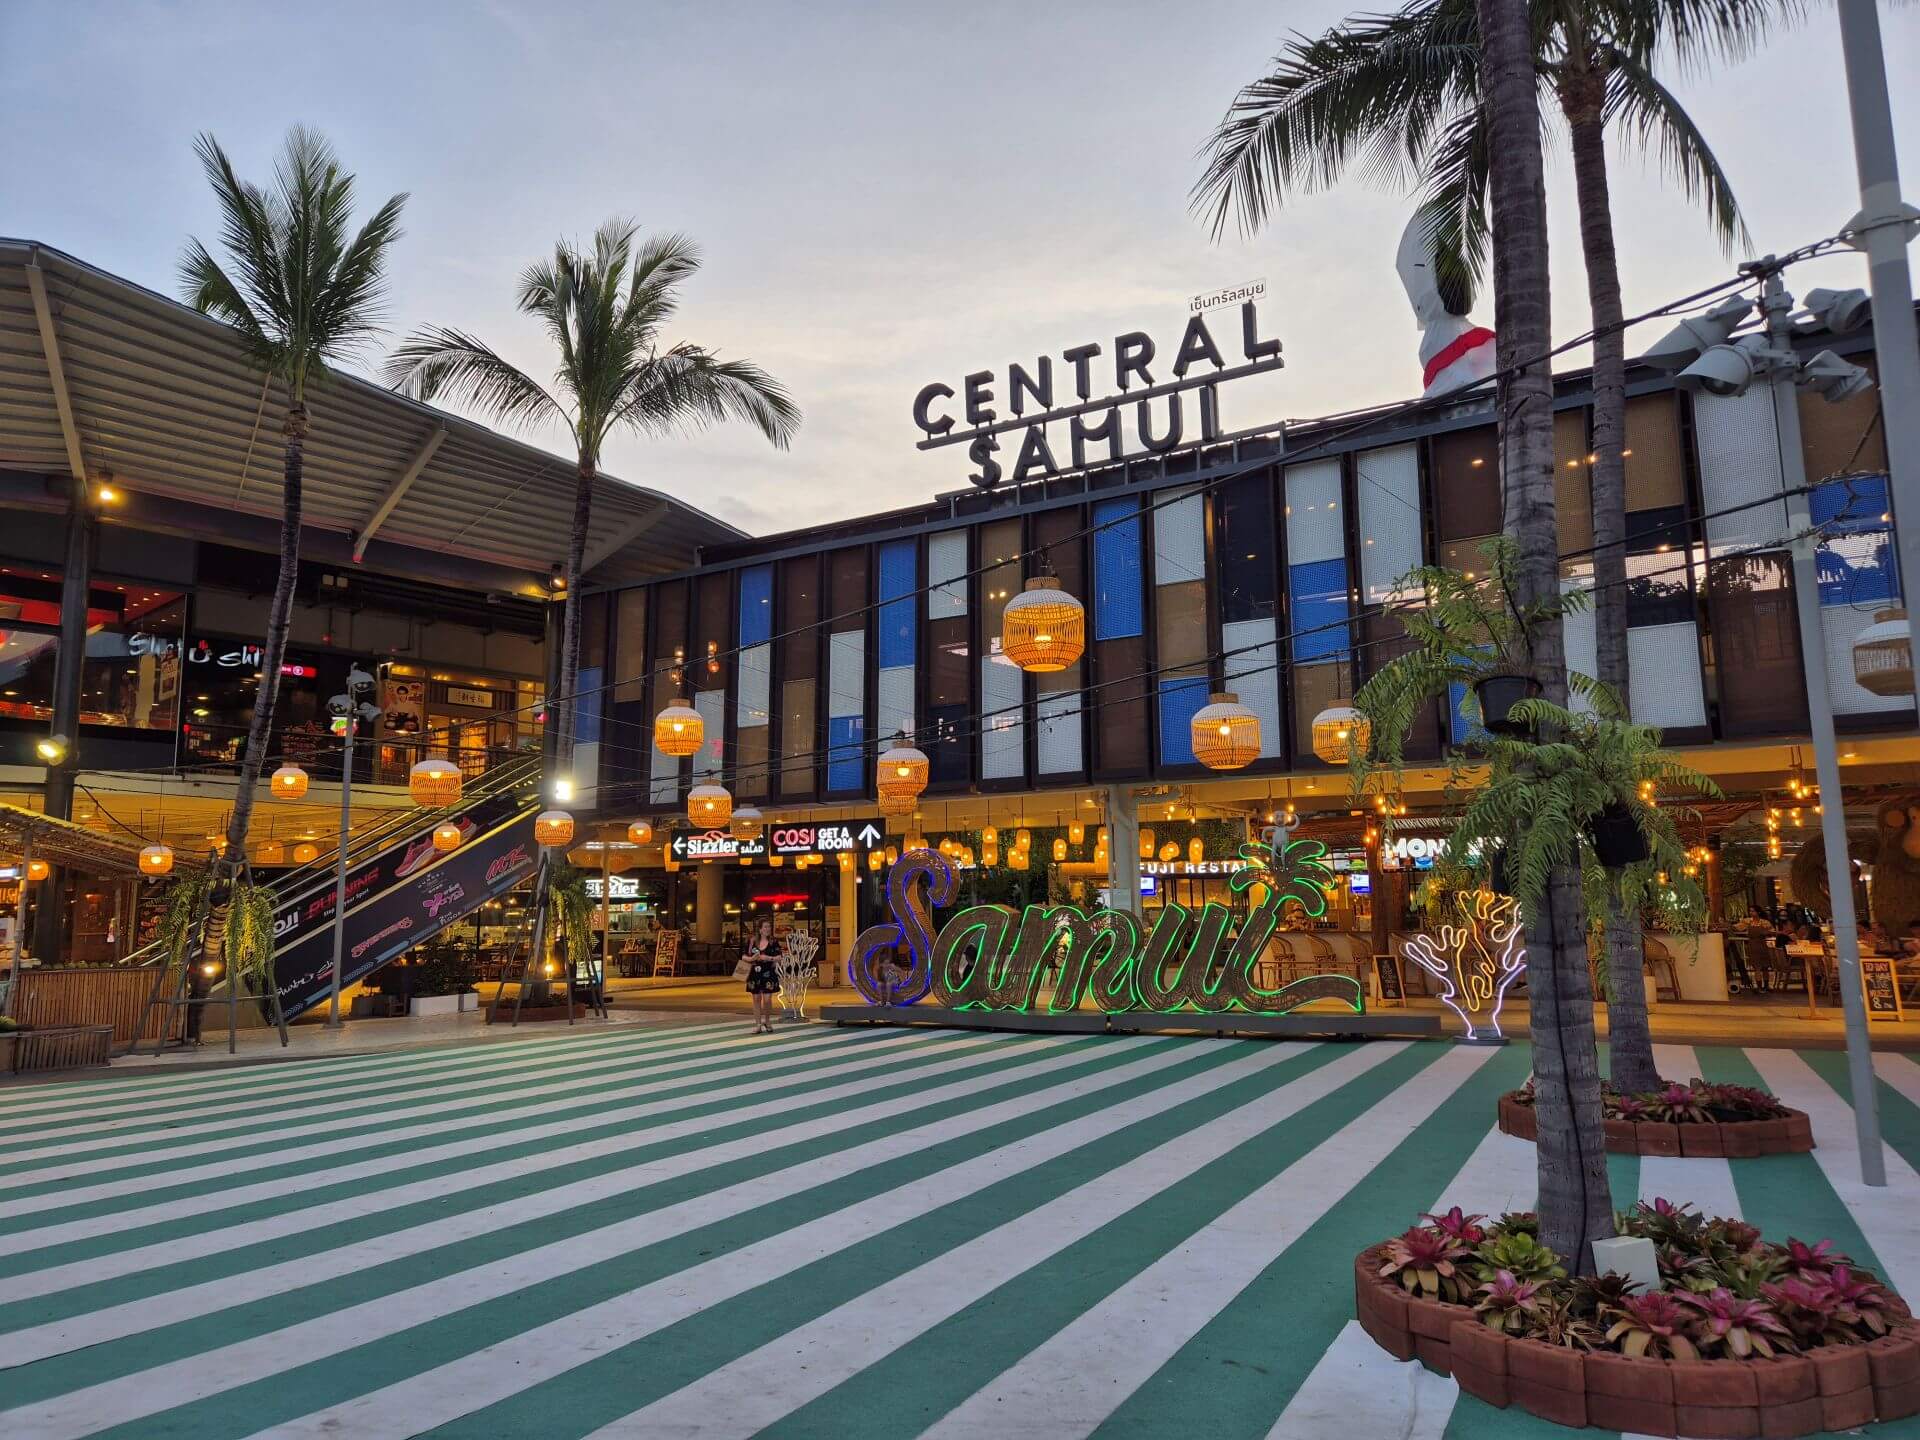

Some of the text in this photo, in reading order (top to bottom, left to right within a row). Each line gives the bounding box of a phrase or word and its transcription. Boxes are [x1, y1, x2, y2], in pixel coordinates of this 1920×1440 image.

[913, 299, 1283, 434] CENTRAL
[968, 384, 1220, 489] SAMUI
[773, 829, 815, 847] COSI
[818, 827, 850, 839] GET A
[687, 839, 738, 855] Sizzler
[818, 838, 853, 849] ROOM
[848, 847, 1366, 1015] Samui
